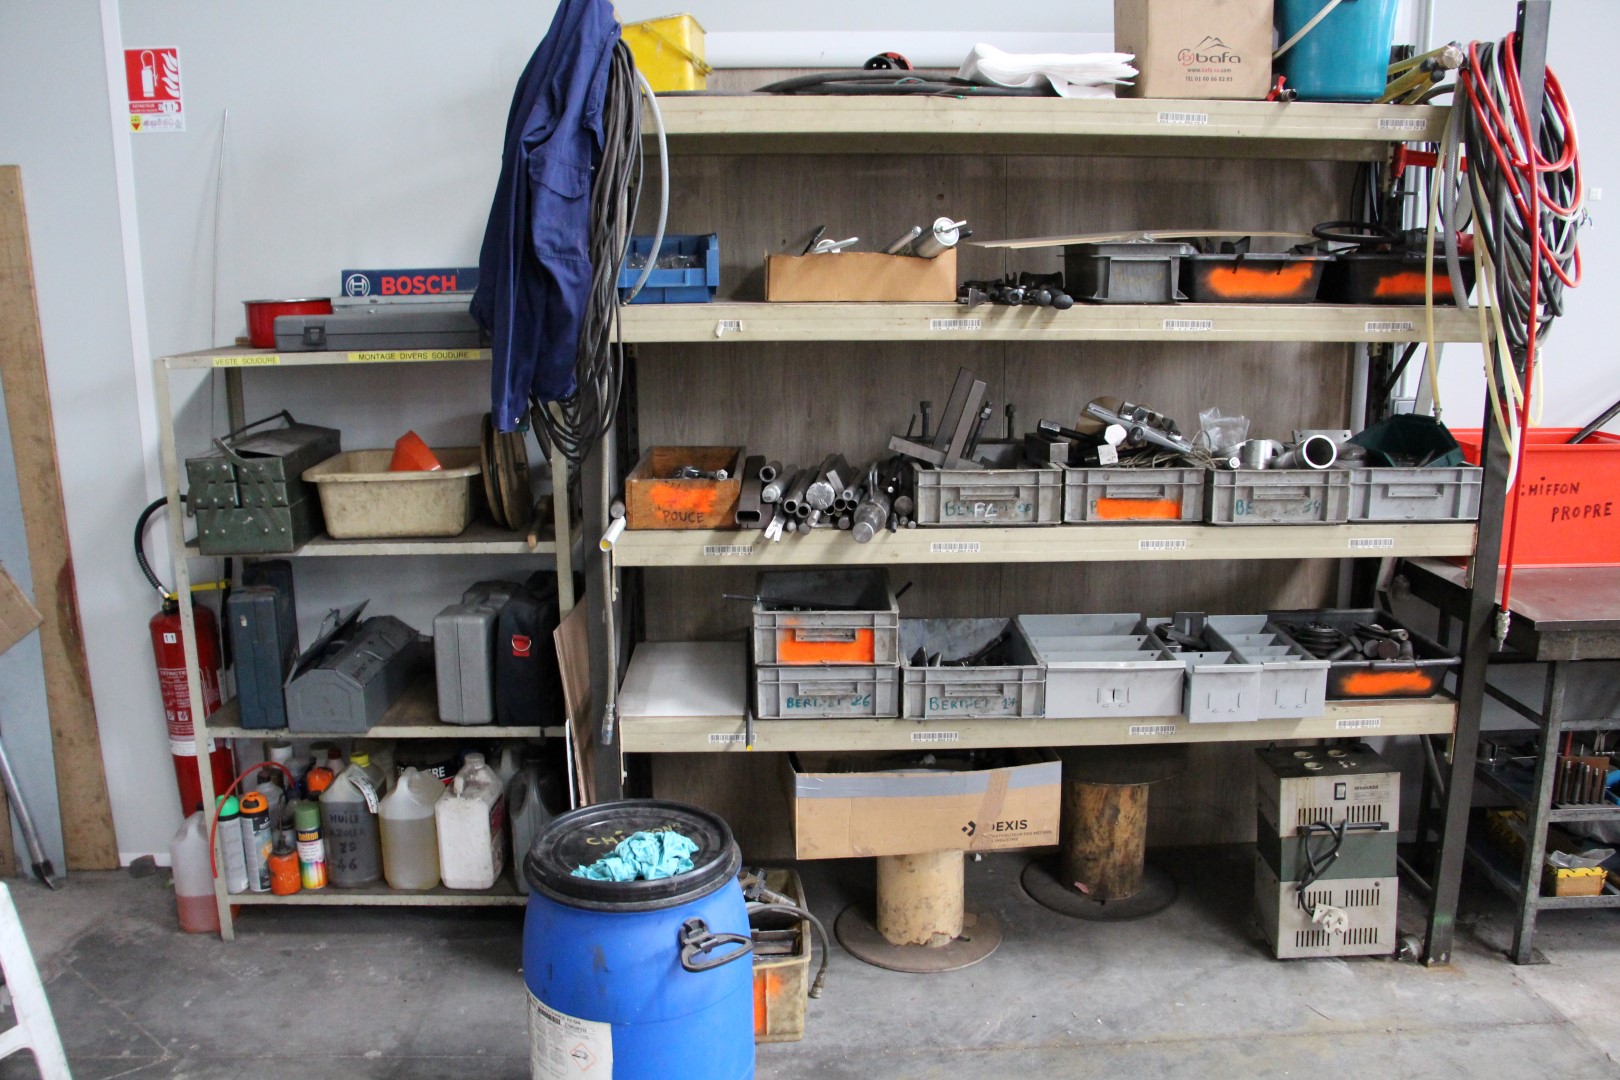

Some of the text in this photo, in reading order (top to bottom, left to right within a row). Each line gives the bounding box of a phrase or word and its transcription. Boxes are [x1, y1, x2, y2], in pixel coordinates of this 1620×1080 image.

[381, 275, 457, 295] BOSCH
[215, 356, 277, 366] VESTE SOUDURE
[358, 351, 469, 361] MONTAGE DIVERS SOUDURE
[662, 510, 704, 523] POUCE
[1551, 502, 1613, 523] PROPRE
[992, 819, 1028, 832] EXIS
